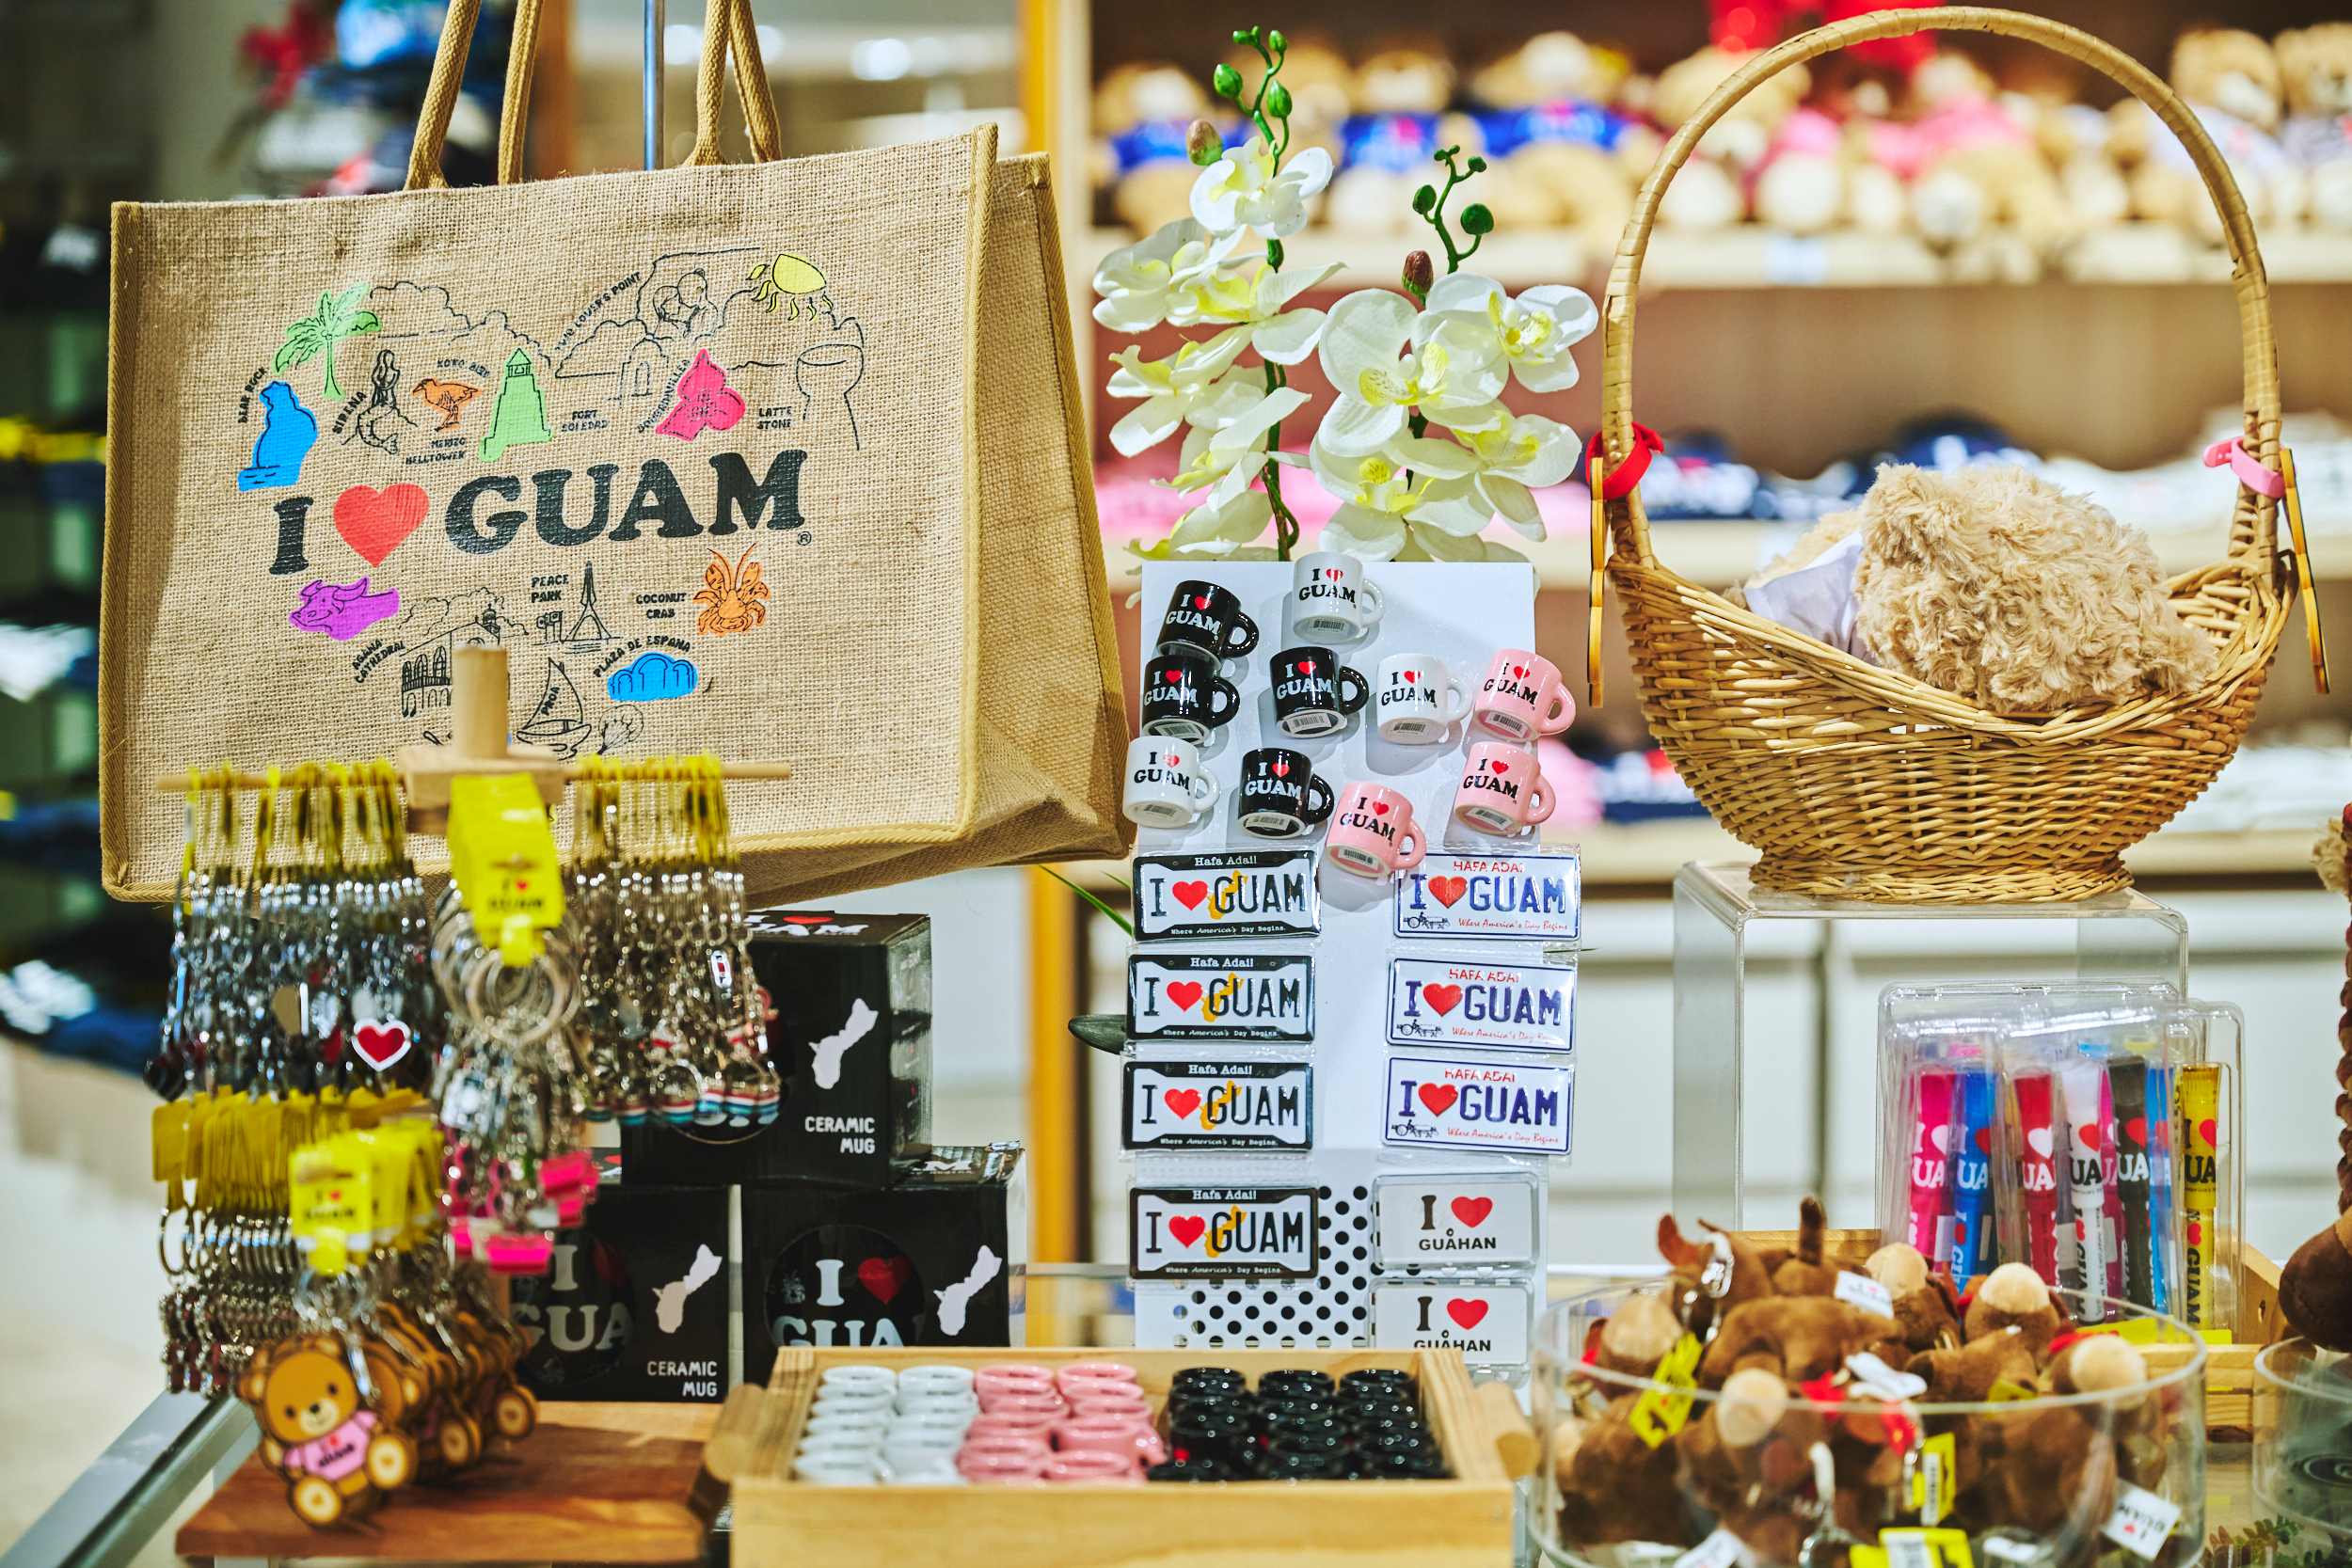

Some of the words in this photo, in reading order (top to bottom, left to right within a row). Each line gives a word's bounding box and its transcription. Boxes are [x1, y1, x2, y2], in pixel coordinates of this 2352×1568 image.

[611, 271, 641, 295] POINT
[437, 358, 467, 369] KOKO
[245, 367, 267, 393] ROCK
[332, 391, 367, 434] SIRENA
[572, 409, 598, 420] FORT
[758, 405, 793, 418] LATTE
[757, 419, 793, 430] STONE
[405, 451, 467, 465] BELLTOWER
[269, 496, 314, 576] I
[444, 449, 809, 556] GUAM
[531, 575, 569, 588] PEACE
[1311, 568, 1321, 581] I
[531, 590, 563, 603] PARK
[636, 593, 688, 605] COCONUT
[1181, 594, 1191, 608] I
[1298, 584, 1356, 604] GUAM
[646, 609, 676, 619] CRAB
[1166, 610, 1222, 635] GUAM
[355, 641, 406, 683] CATHEDRAL
[593, 647, 626, 677] PLAZA
[628, 638, 643, 652] DE
[1285, 663, 1294, 677] I
[1502, 662, 1509, 675] I
[1153, 671, 1161, 685] I
[1391, 672, 1399, 685] I
[1144, 686, 1198, 706] GUAM
[1277, 677, 1334, 700] GUAM
[1381, 687, 1437, 705] GUAM
[1484, 679, 1538, 705] GUAM
[540, 686, 561, 717] PROA
[1149, 752, 1157, 765] I
[1478, 758, 1488, 771] I
[1258, 762, 1267, 776] I
[1134, 769, 1191, 790] GUAM
[1463, 775, 1519, 800] GUAM
[1245, 779, 1302, 799] GUAM
[1358, 797, 1368, 810] I
[1340, 813, 1396, 842] GUAM
[1195, 857, 1223, 866] Hafa
[1454, 861, 1486, 873] HAFA
[1150, 878, 1167, 916] I
[1215, 873, 1308, 913] GUAM
[1410, 873, 1428, 910] I
[1470, 876, 1566, 913] GUAM
[1459, 918, 1481, 927] Where
[1190, 958, 1219, 967] Hafa
[1449, 968, 1483, 981] HAFA
[1144, 976, 1160, 1016] I
[1209, 978, 1301, 1018] GUAM
[1404, 980, 1422, 1017] I
[1465, 984, 1562, 1026] GUAM
[1188, 1065, 1217, 1074] Hafa
[1444, 1068, 1479, 1080] HAFA
[1141, 1085, 1157, 1124] I
[1207, 1085, 1299, 1126] GUAM
[1399, 1080, 1418, 1117] I
[1460, 1084, 1558, 1126] GUAM
[804, 1117, 876, 1134] CERAMIC
[839, 1138, 876, 1155] MUG
[1192, 1190, 1222, 1200] Hafa
[1421, 1195, 1437, 1230] I
[1146, 1212, 1162, 1253] I
[1212, 1212, 1303, 1253] GUAM
[551, 1244, 579, 1291] I
[816, 1259, 845, 1307] I
[2186, 1247, 2201, 1325] GUAM
[1416, 1296, 1433, 1331] I
[647, 1361, 718, 1376] CERAMIC
[682, 1382, 718, 1397] MUG
